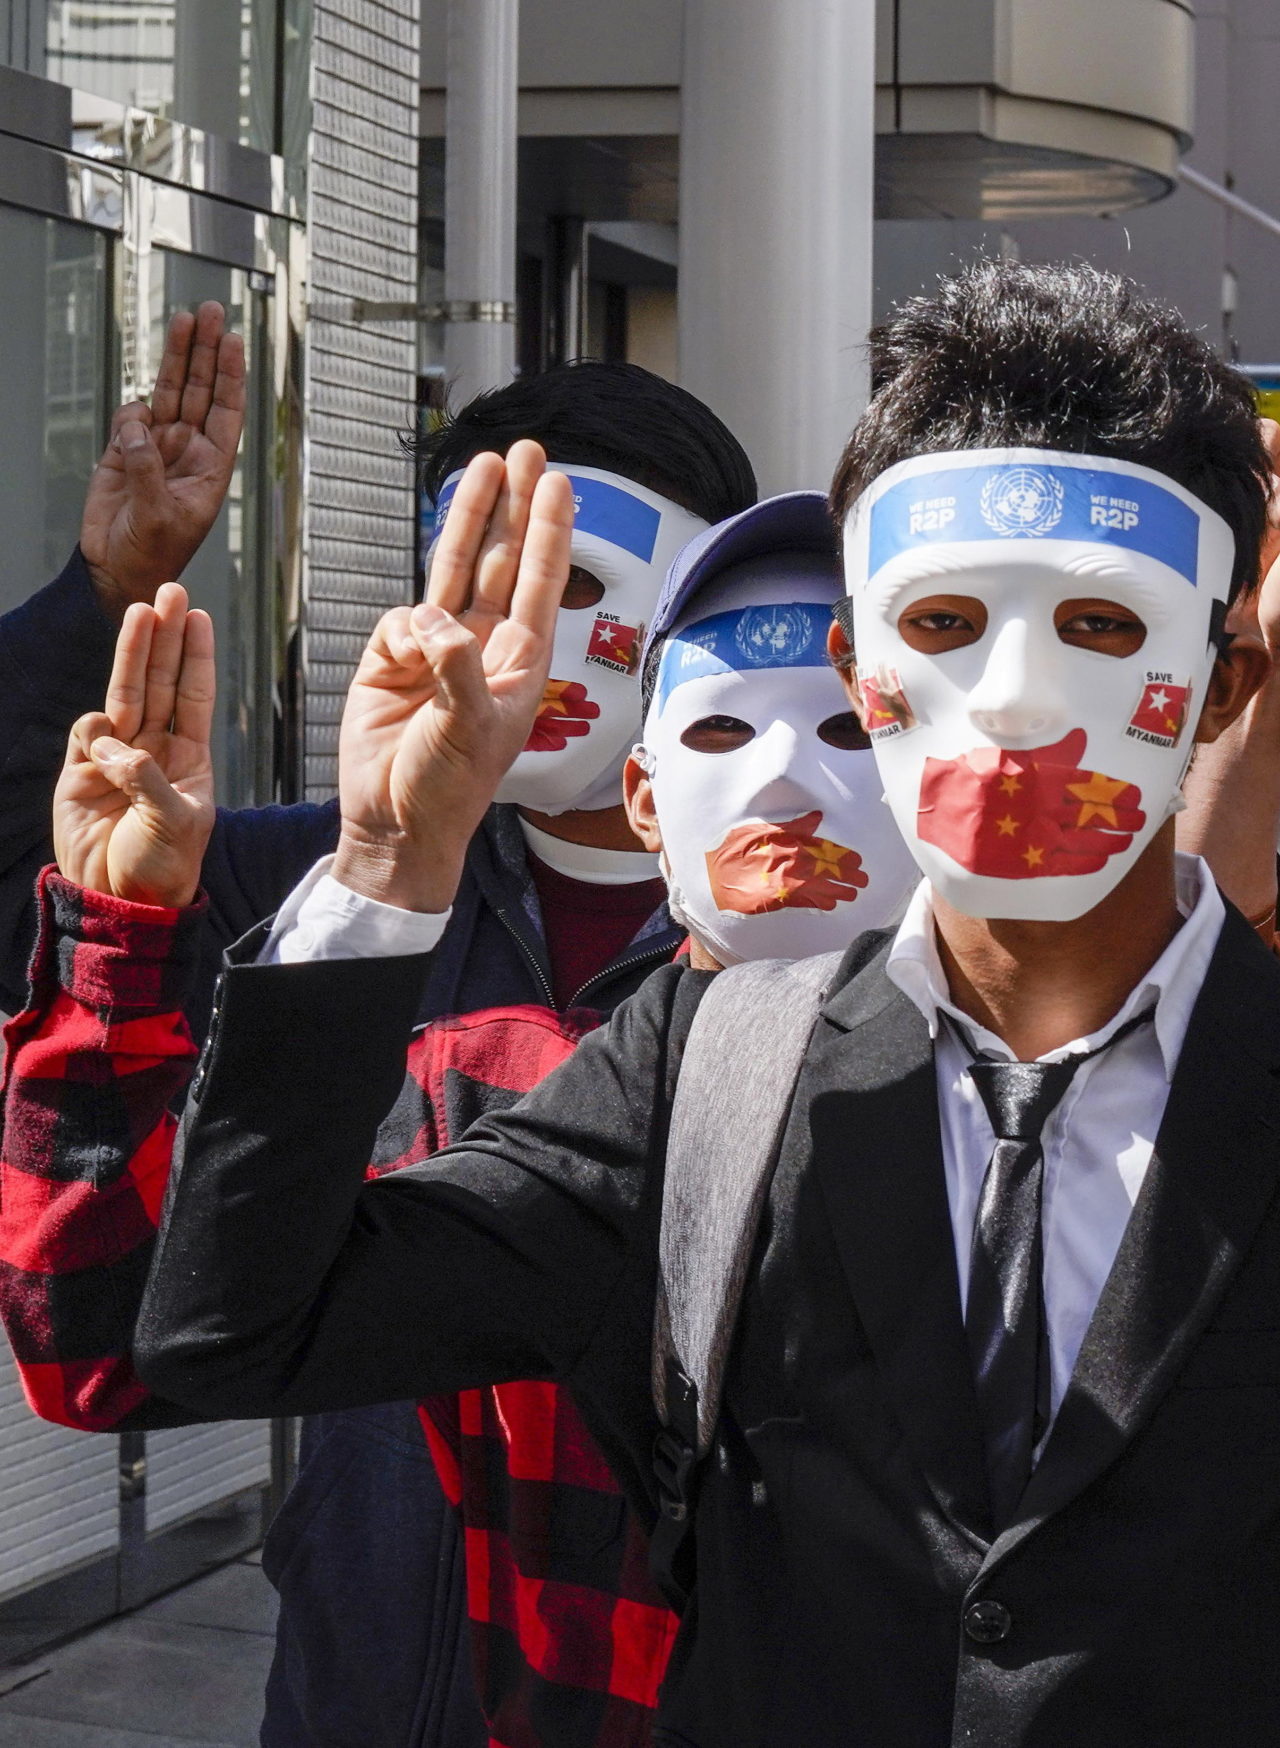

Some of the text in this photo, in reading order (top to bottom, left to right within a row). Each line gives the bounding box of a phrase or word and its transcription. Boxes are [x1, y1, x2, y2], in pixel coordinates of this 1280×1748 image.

[909, 497, 956, 513] WE NEED
[1090, 494, 1139, 512] WE NEED
[909, 508, 956, 535] R2P
[1090, 506, 1139, 531] R2P
[596, 611, 621, 623] SAVE
[1146, 672, 1173, 683] SAVE
[1126, 726, 1173, 748] MYANMAR
